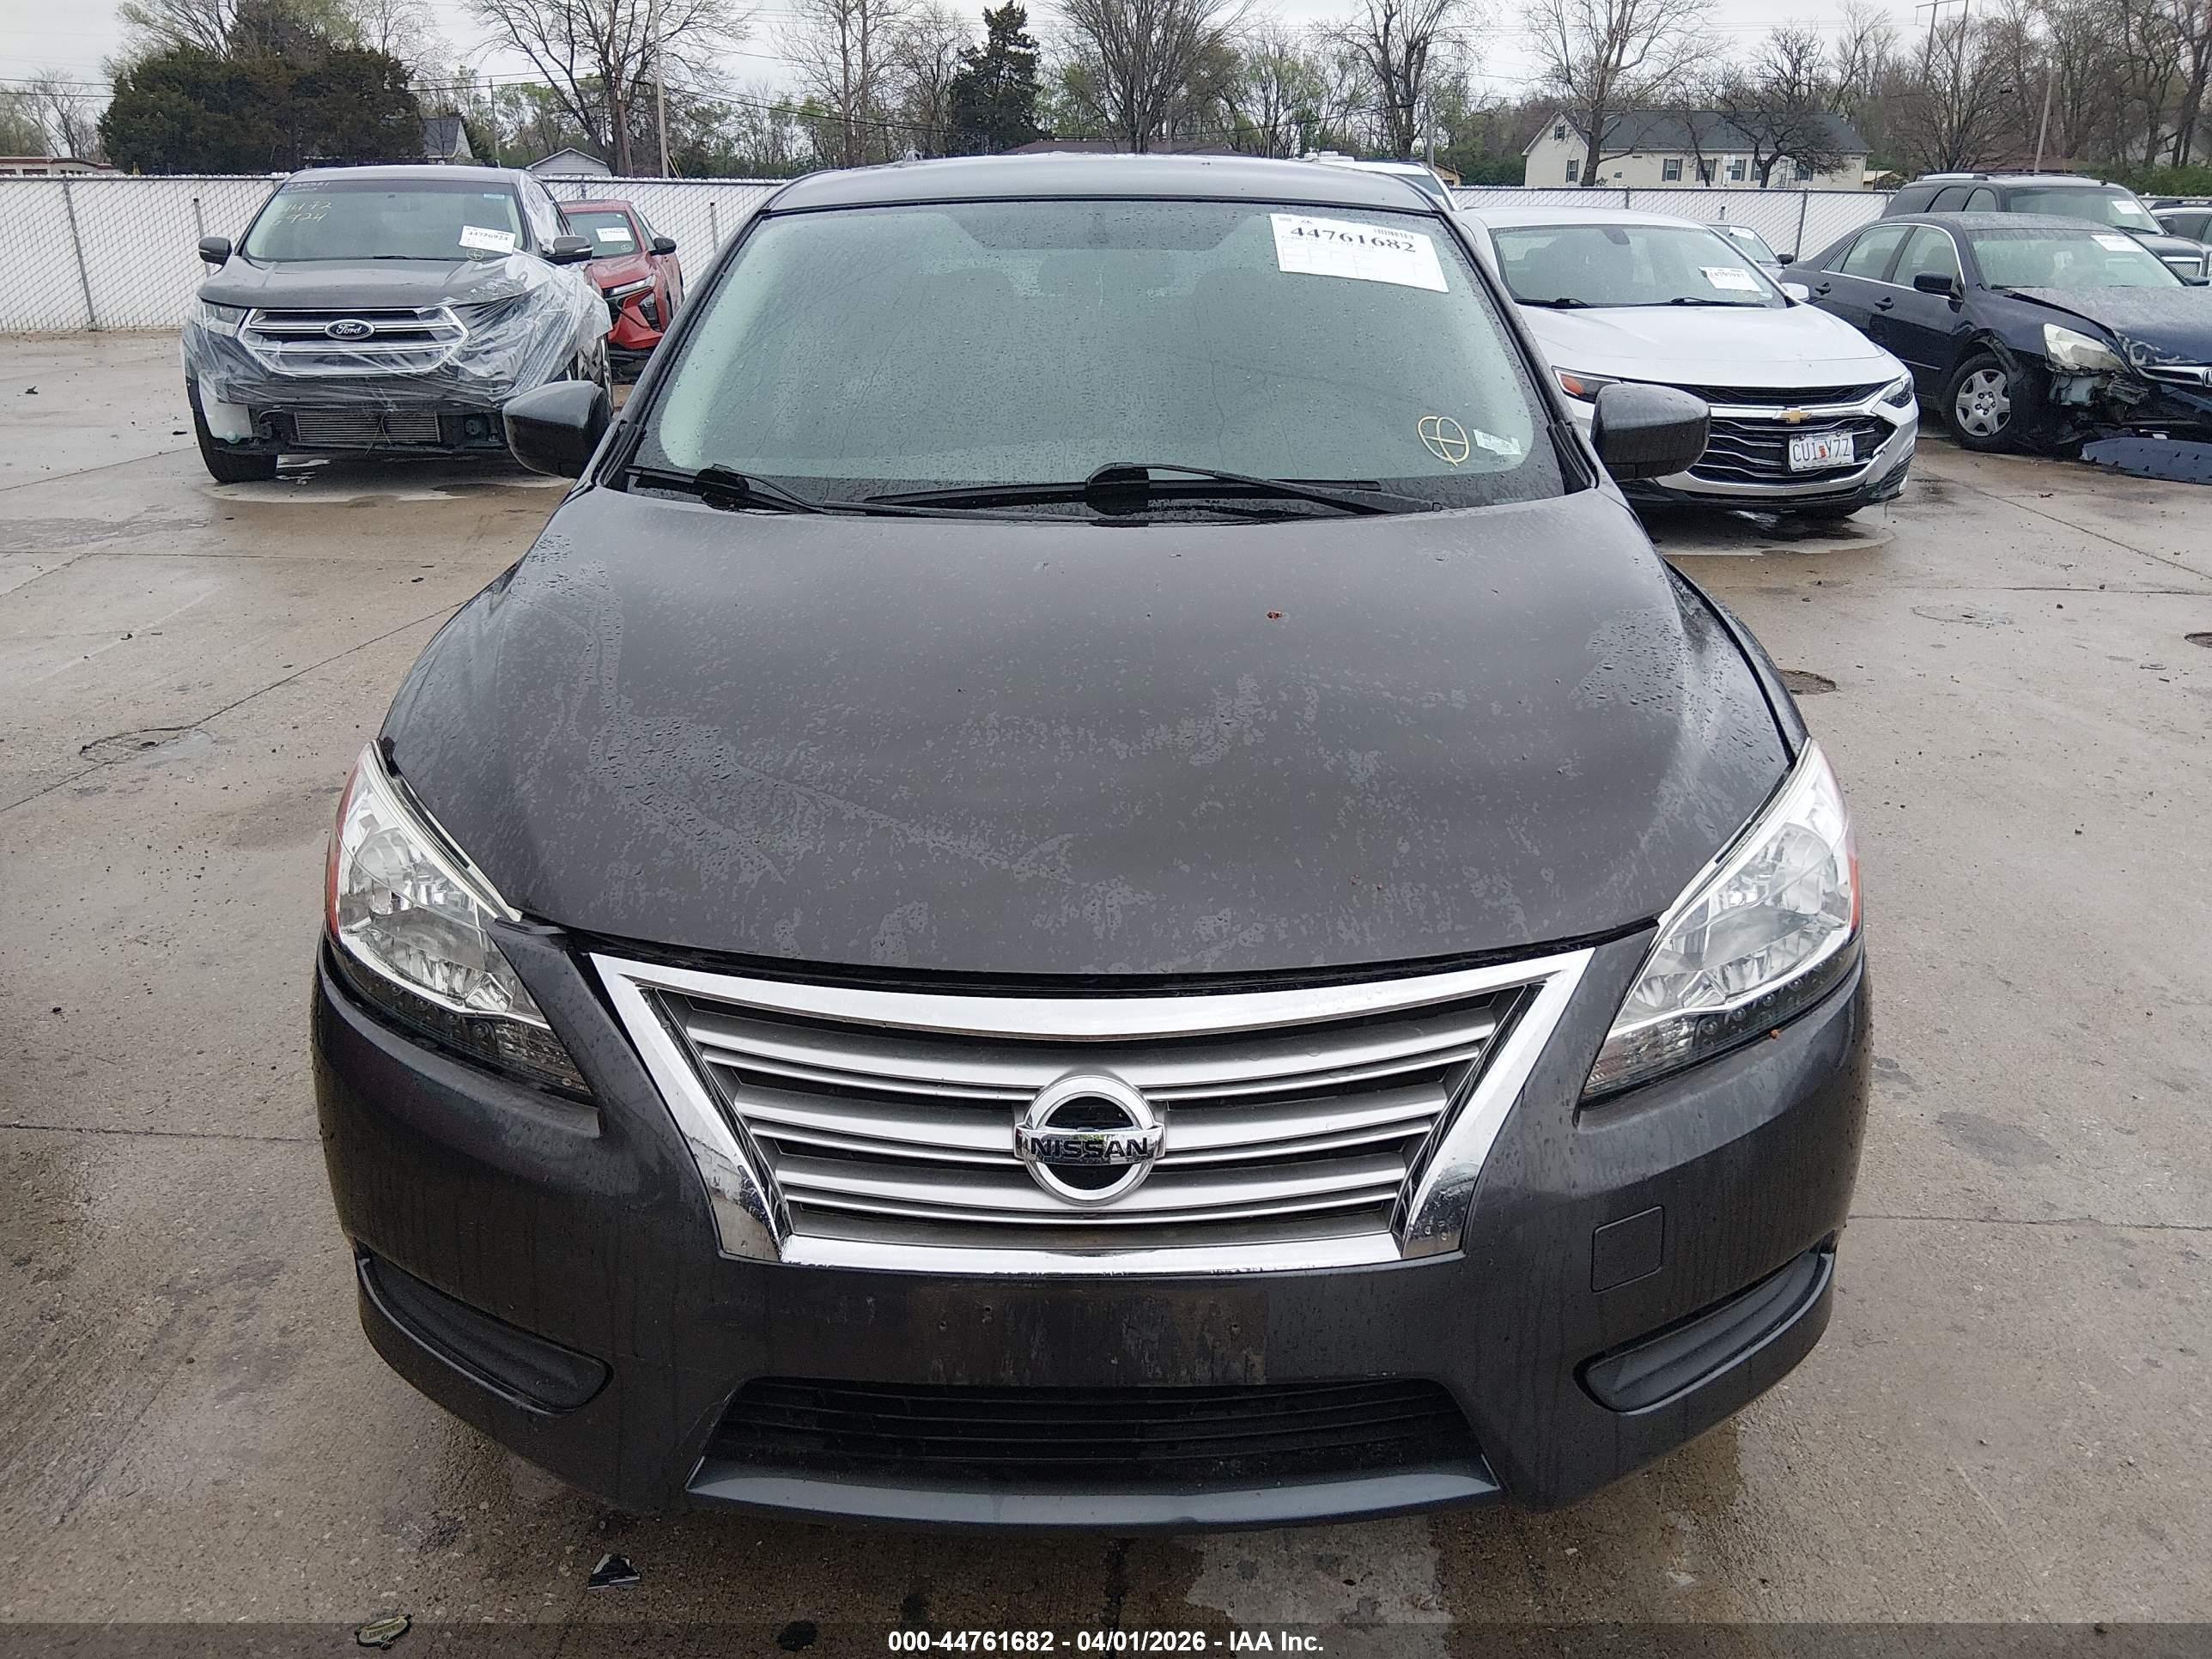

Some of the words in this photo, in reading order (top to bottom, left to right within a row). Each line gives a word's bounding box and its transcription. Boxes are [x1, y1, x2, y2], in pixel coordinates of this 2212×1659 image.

[1291, 227, 1416, 252] 44761682
[336, 323, 362, 335] Ford
[1030, 1137, 1148, 1158] NISSAN
